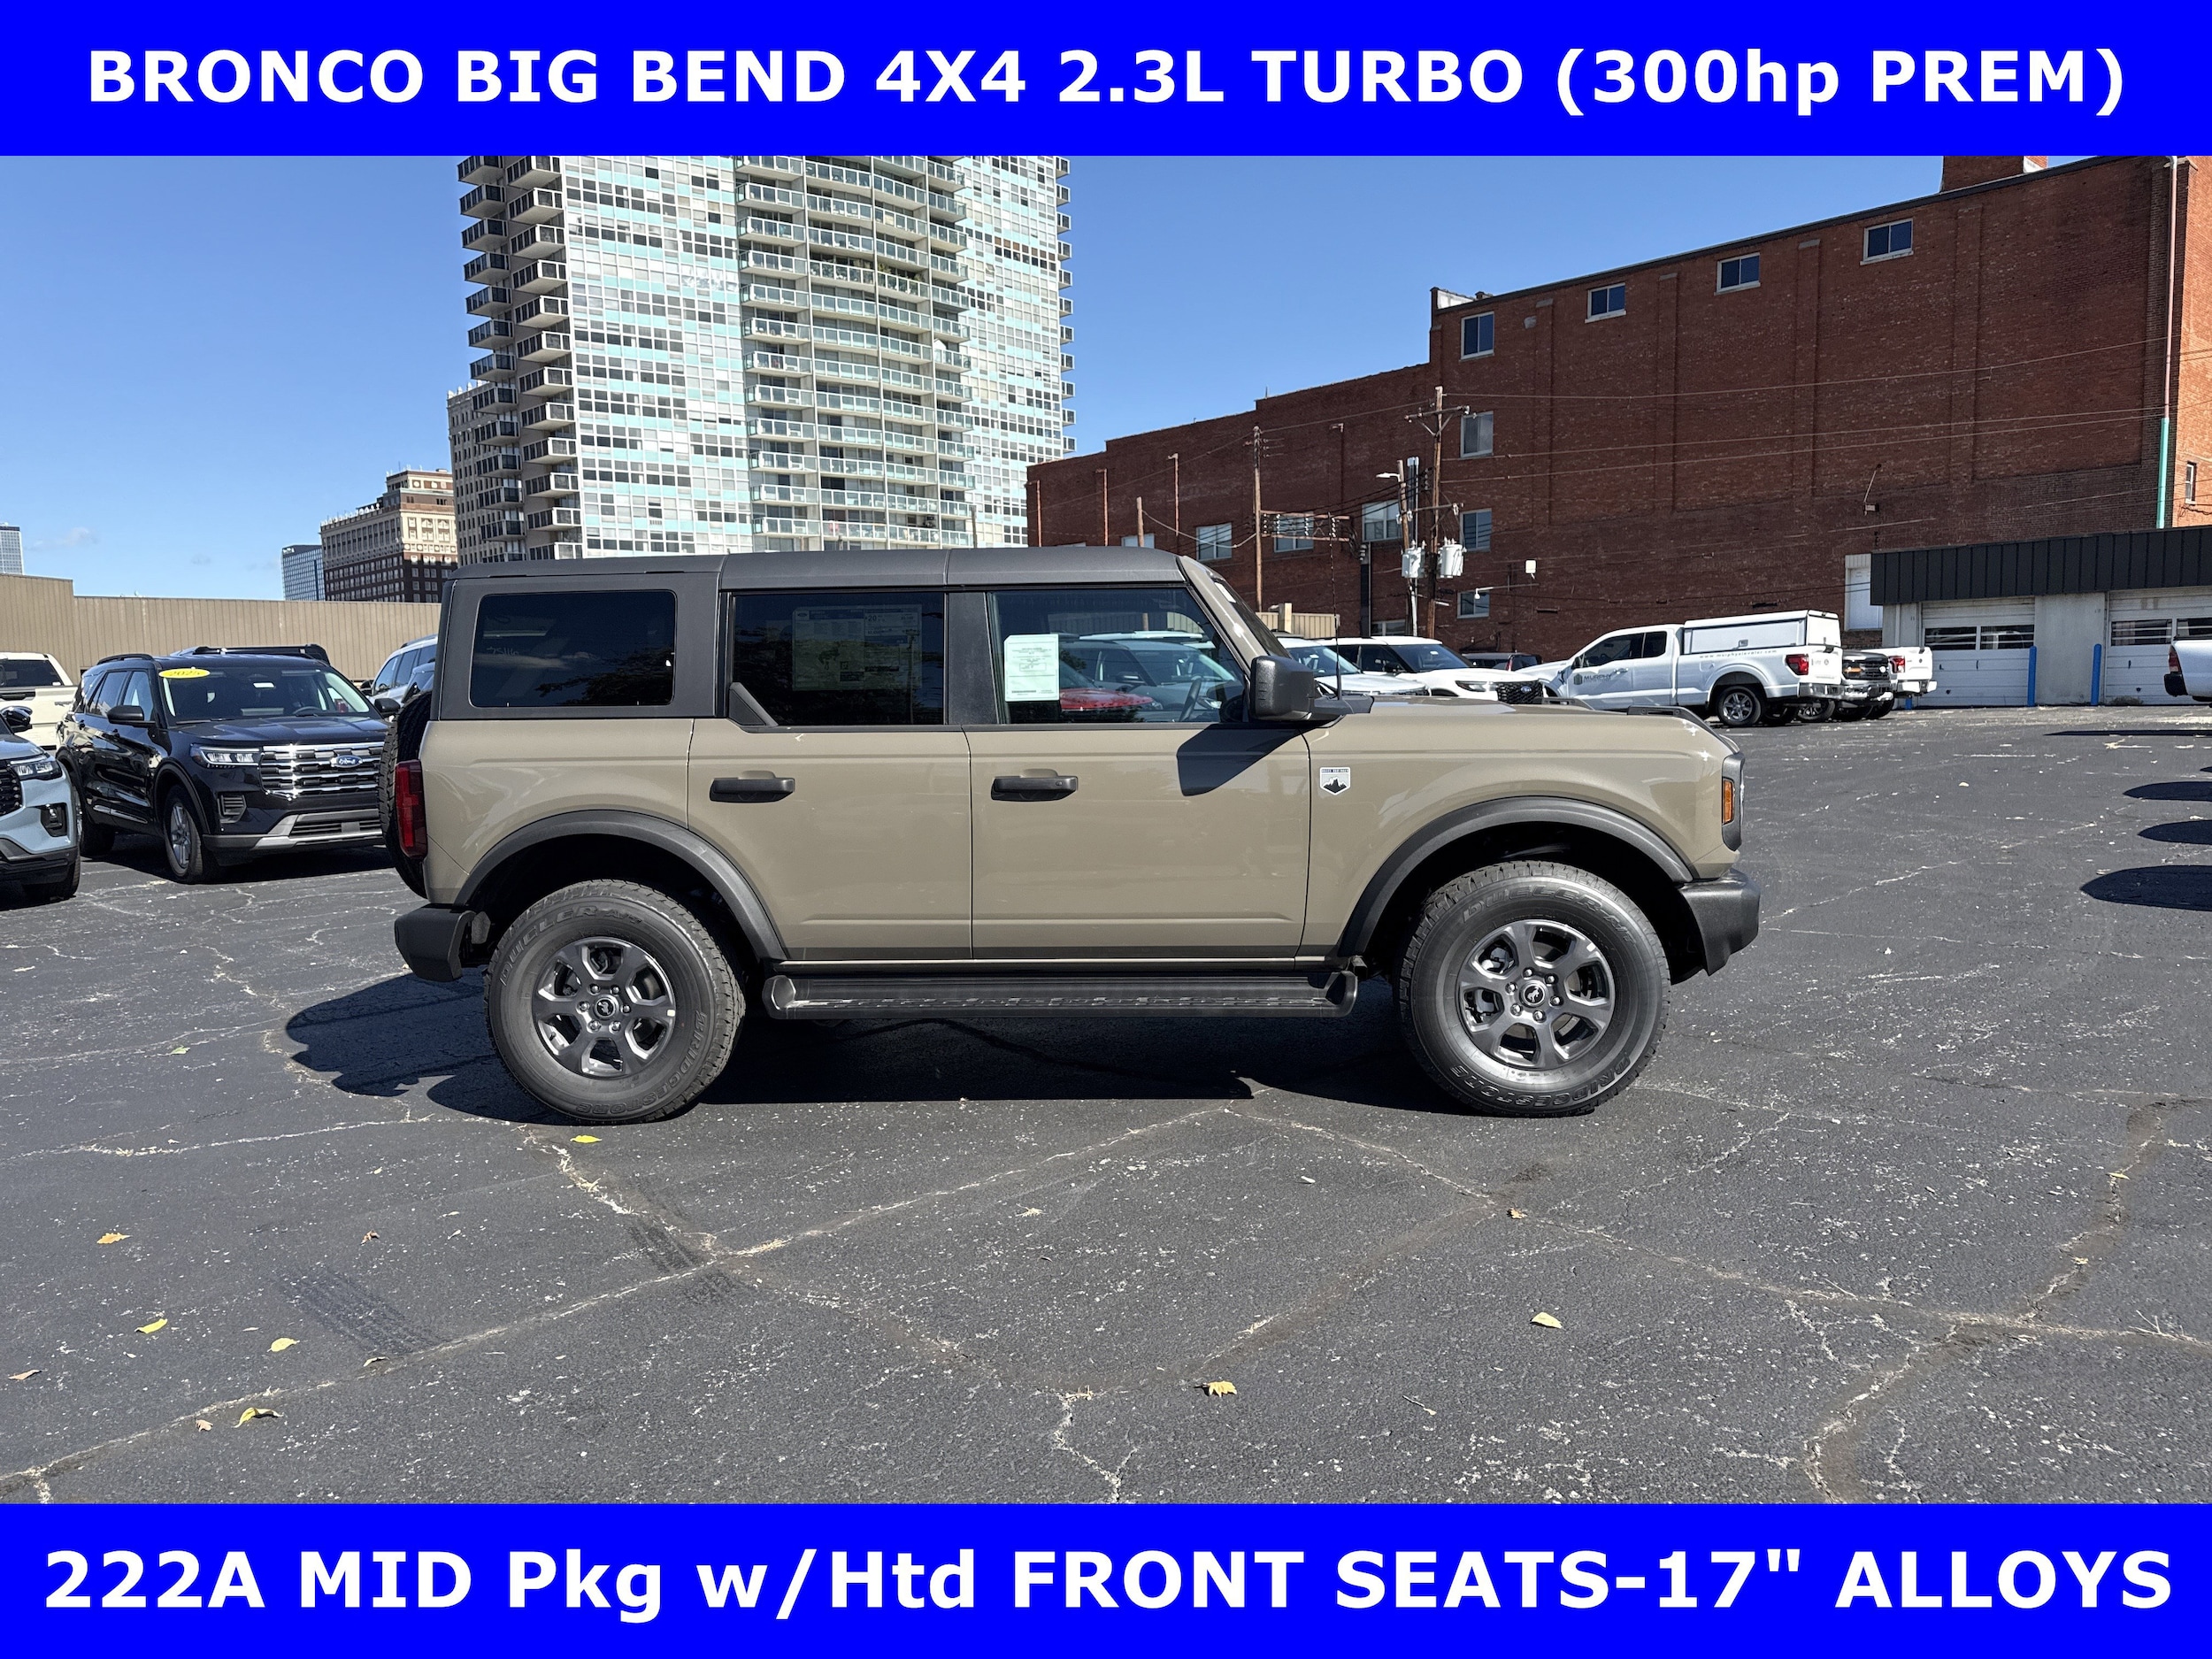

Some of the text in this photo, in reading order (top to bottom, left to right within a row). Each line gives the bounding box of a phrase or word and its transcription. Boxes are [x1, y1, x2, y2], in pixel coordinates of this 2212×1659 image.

[1462, 885, 1603, 923] DUELER
[500, 904, 598, 987] DUELER
[576, 1010, 708, 1115] BRIDGESTONE
[1449, 1051, 1632, 1108] BRIDGESTONE
